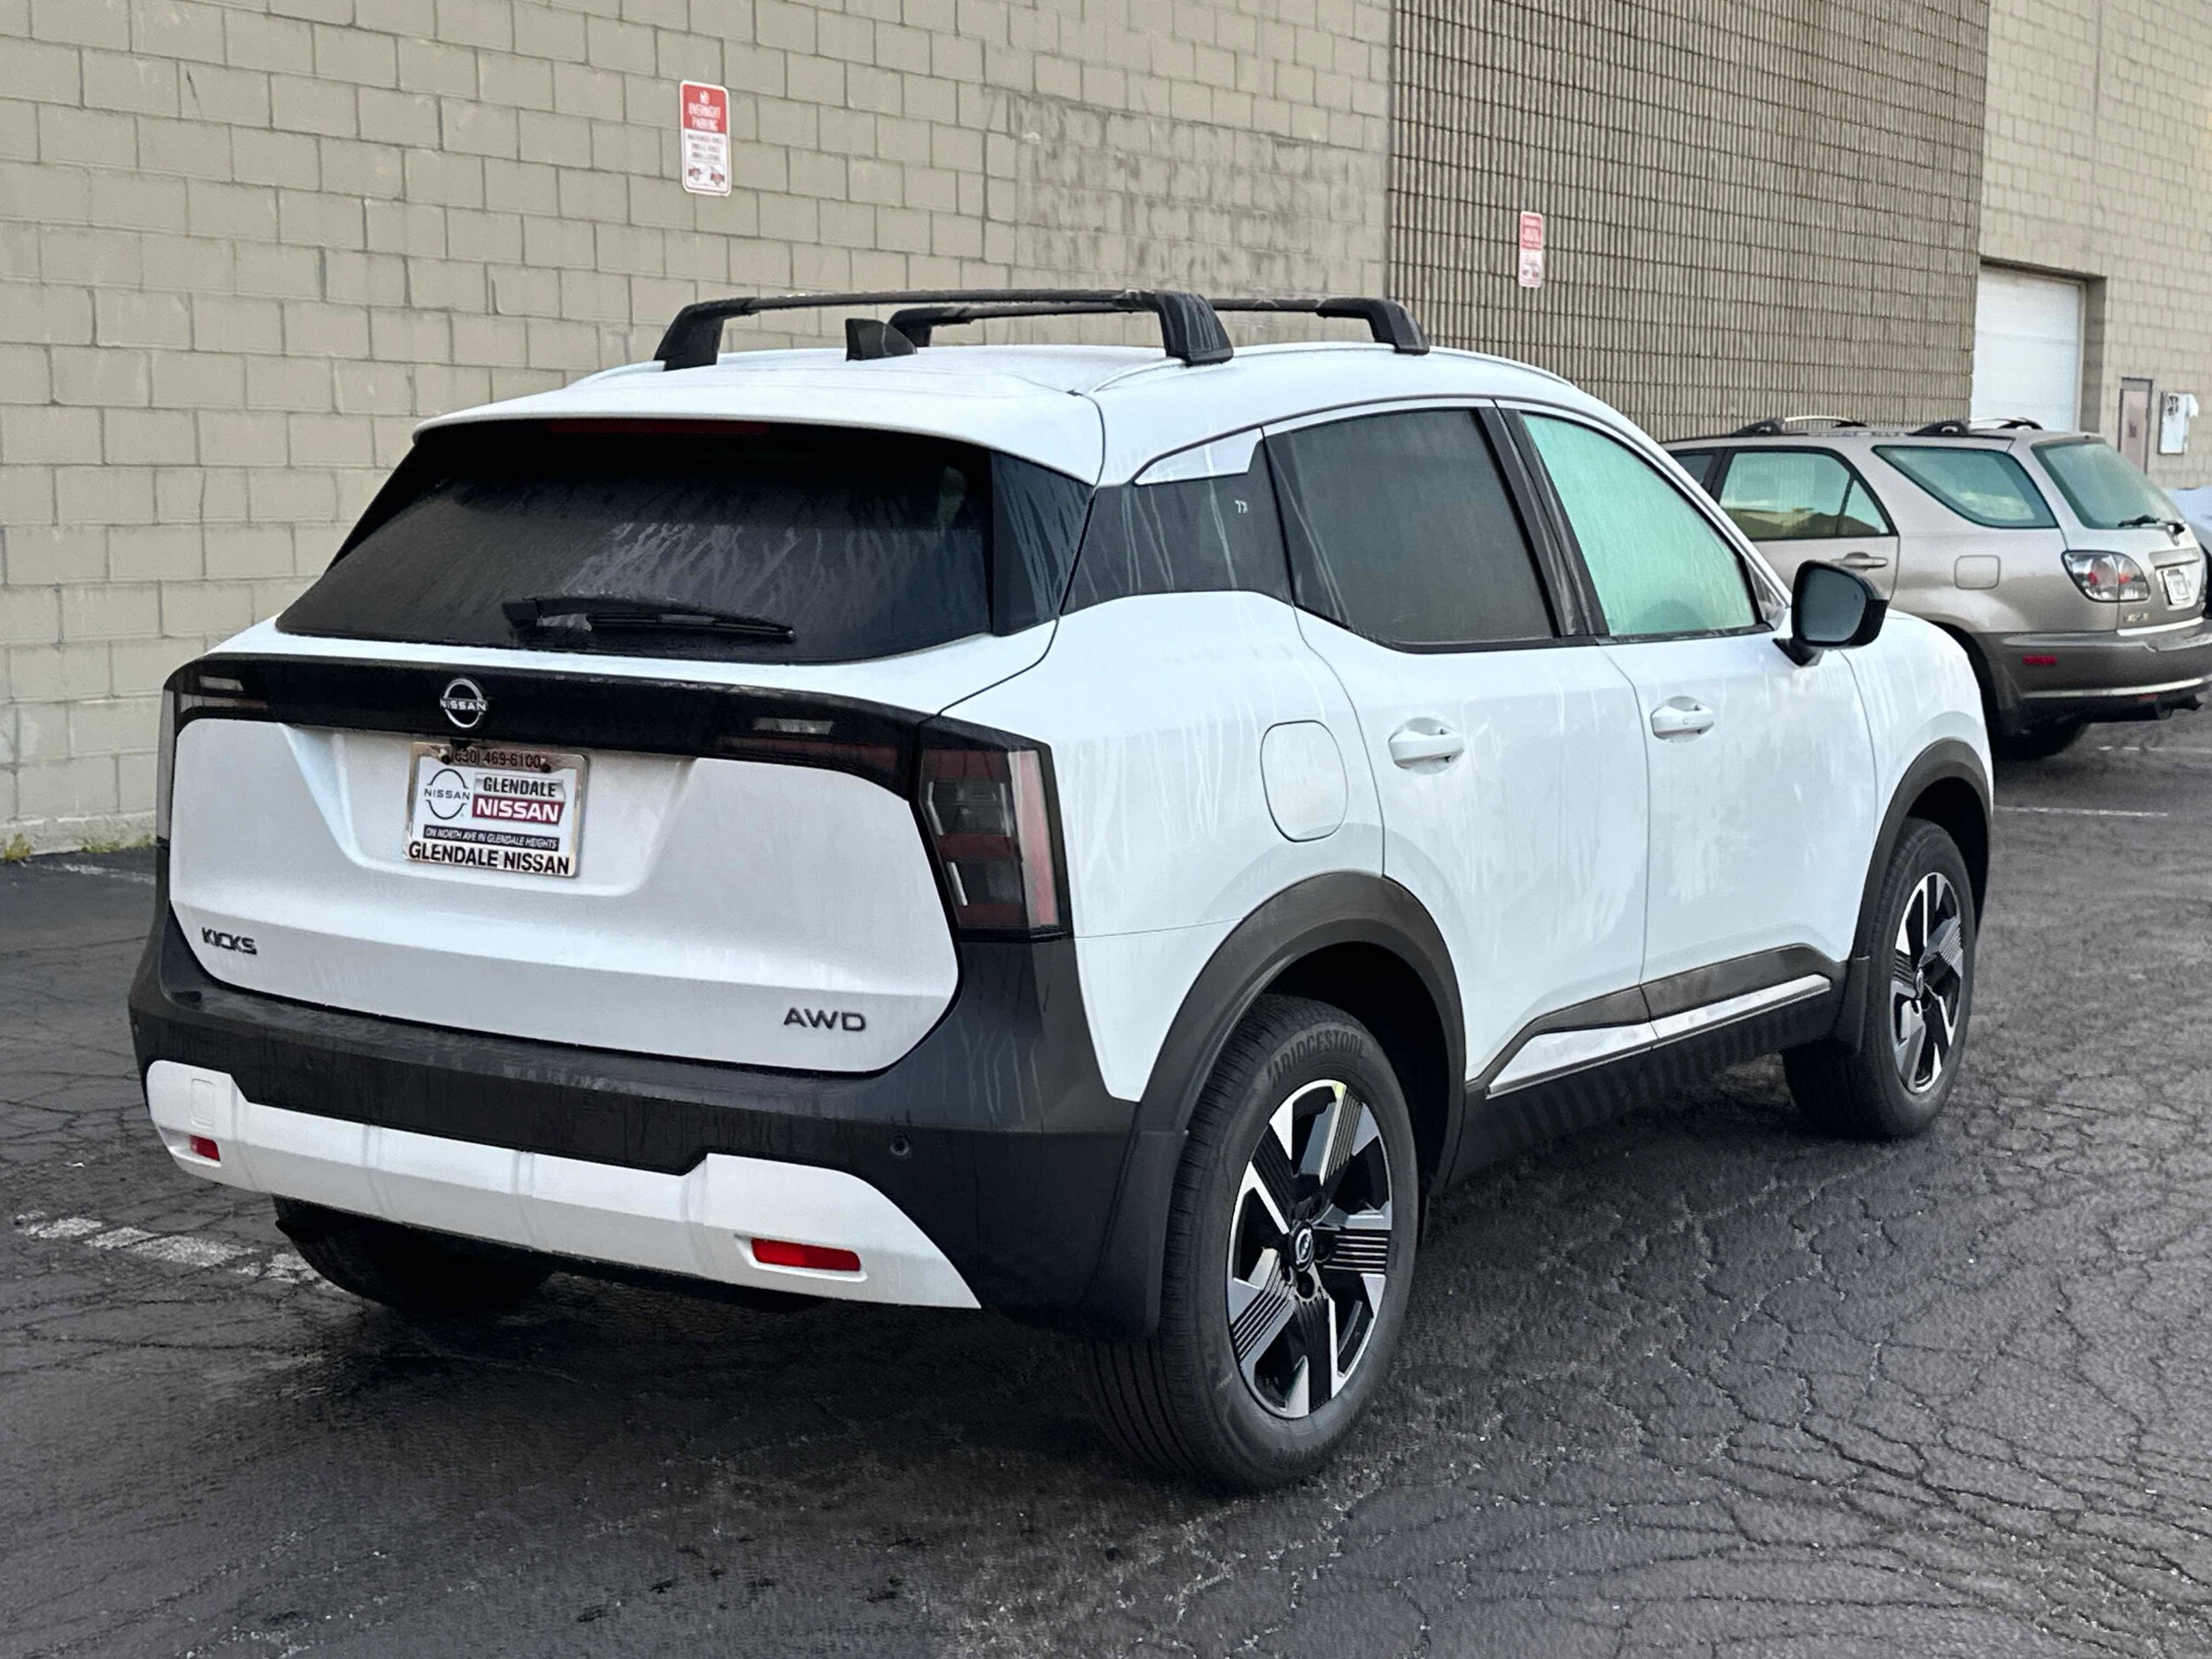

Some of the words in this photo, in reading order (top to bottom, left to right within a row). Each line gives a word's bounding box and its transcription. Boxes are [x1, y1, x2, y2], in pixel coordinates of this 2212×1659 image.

[440, 698, 487, 711] NISSAN
[425, 788, 471, 801] NISSAN
[483, 777, 557, 797] GLENDALE
[476, 797, 559, 822] NISSAN
[426, 826, 437, 837] ON
[437, 828, 461, 839] NORTH
[462, 831, 477, 841] AVE
[478, 833, 486, 842] IN
[487, 833, 525, 846] GLENDALE
[525, 837, 557, 849] HEIGHTS
[408, 841, 499, 867] GLENDALE
[503, 850, 570, 875] NISSAN
[202, 927, 257, 955] KICKS
[783, 1007, 866, 1032] AWD
